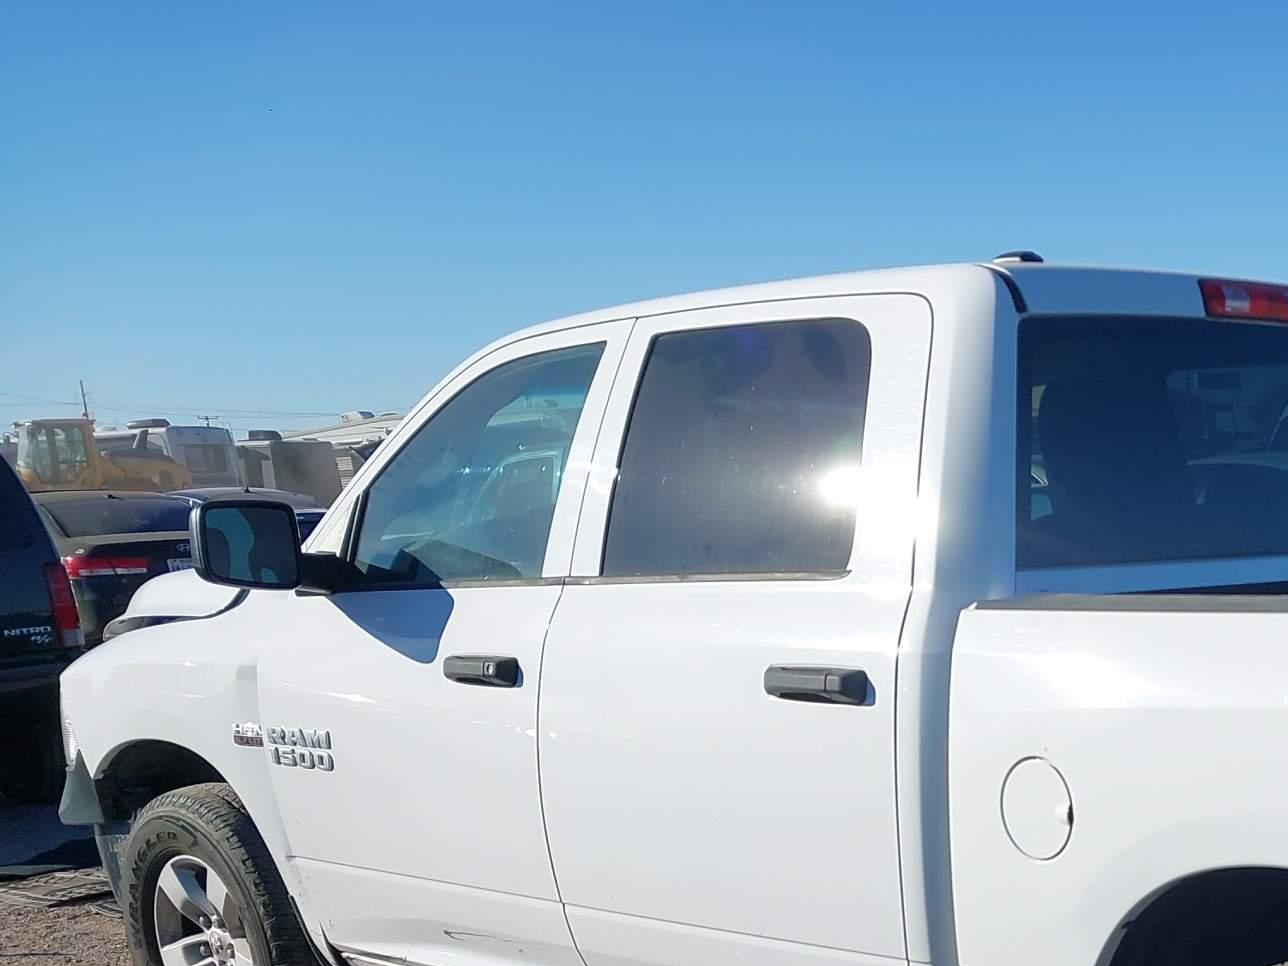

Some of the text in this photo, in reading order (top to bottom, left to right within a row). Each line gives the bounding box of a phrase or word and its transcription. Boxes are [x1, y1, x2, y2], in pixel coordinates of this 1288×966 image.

[3, 625, 51, 637] NITRO
[266, 725, 332, 750] RAM
[269, 745, 335, 772] 1500
[128, 831, 178, 949] WRANGLER
